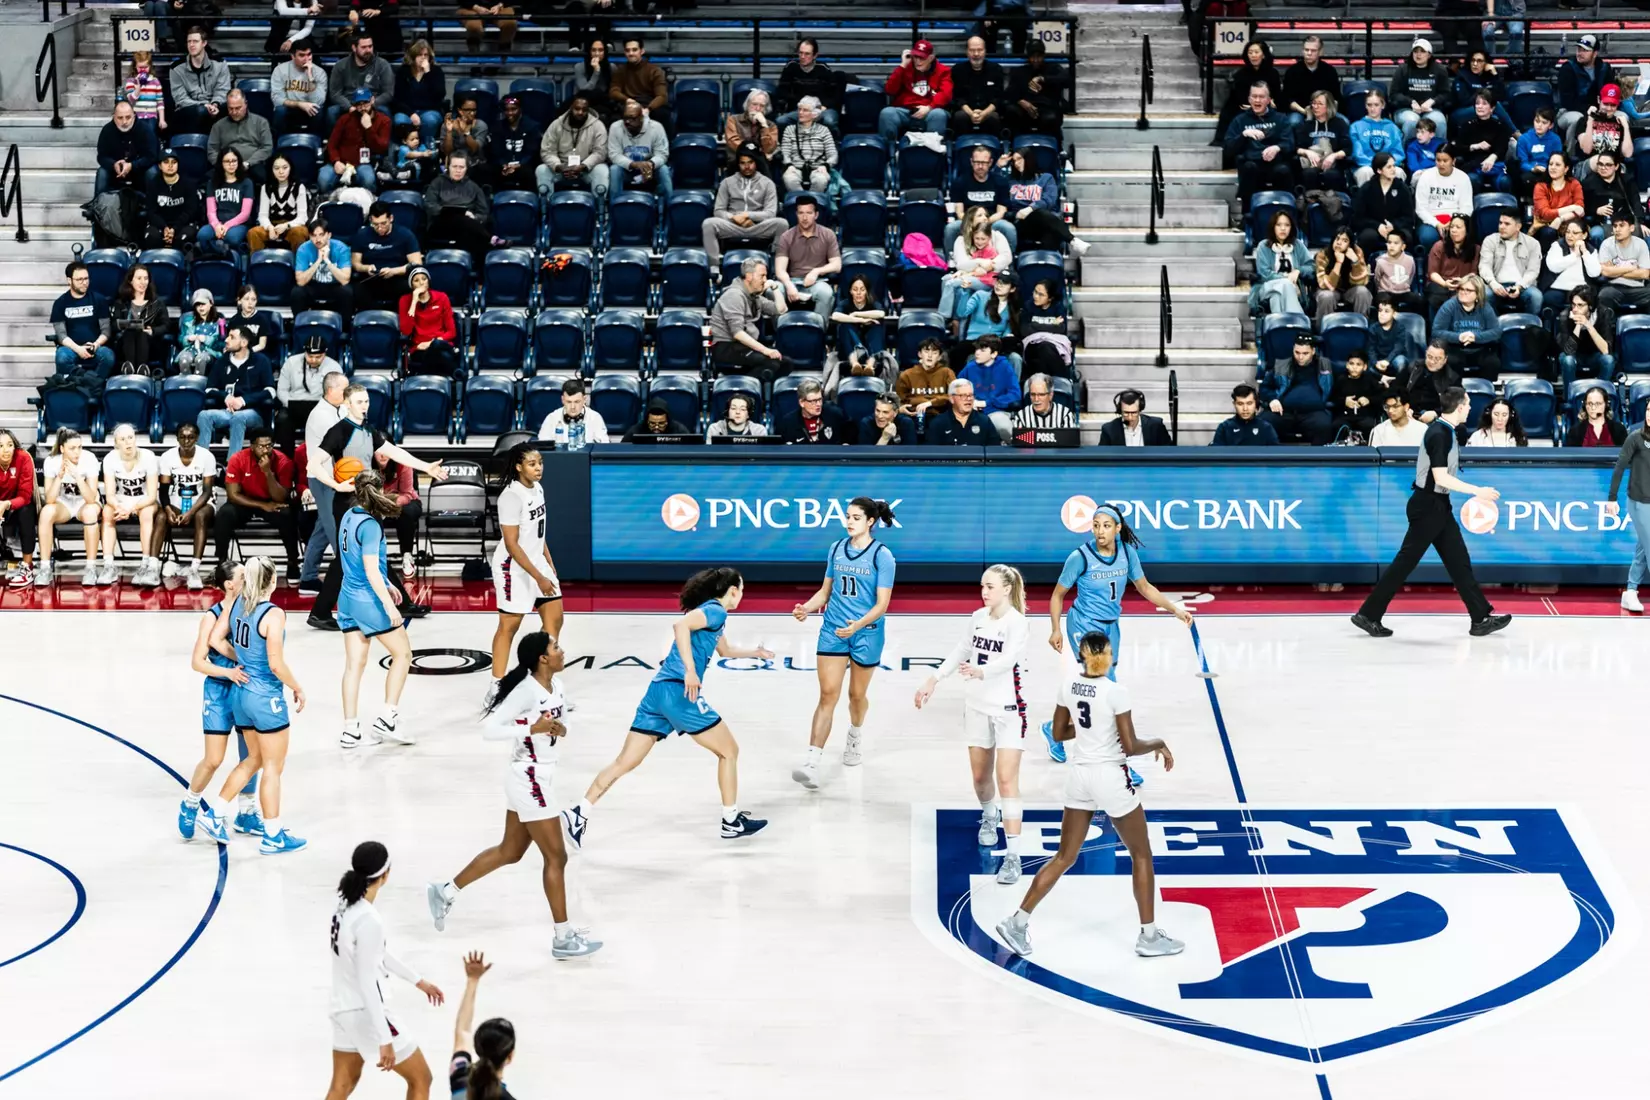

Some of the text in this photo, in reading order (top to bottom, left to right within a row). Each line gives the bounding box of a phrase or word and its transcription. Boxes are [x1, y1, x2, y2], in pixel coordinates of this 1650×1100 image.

[125, 29, 150, 42] 103
[1038, 30, 1062, 43] 103
[1219, 31, 1245, 43] 104
[214, 187, 241, 204] PENN
[1009, 183, 1042, 202] PENN
[1429, 186, 1456, 196] PENN
[166, 197, 185, 207] Penn
[1036, 432, 1057, 444] POSS.
[705, 498, 790, 529] PNC
[1193, 499, 1303, 530] BANK
[1503, 500, 1589, 532] PNC
[537, 518, 545, 539] 0
[841, 575, 858, 598] 11
[1109, 581, 1117, 601] 1
[235, 618, 250, 650] 10
[1071, 682, 1096, 699] ROGERS
[269, 697, 283, 714] C
[1077, 700, 1092, 729] 3
[990, 820, 1518, 857] PENN
